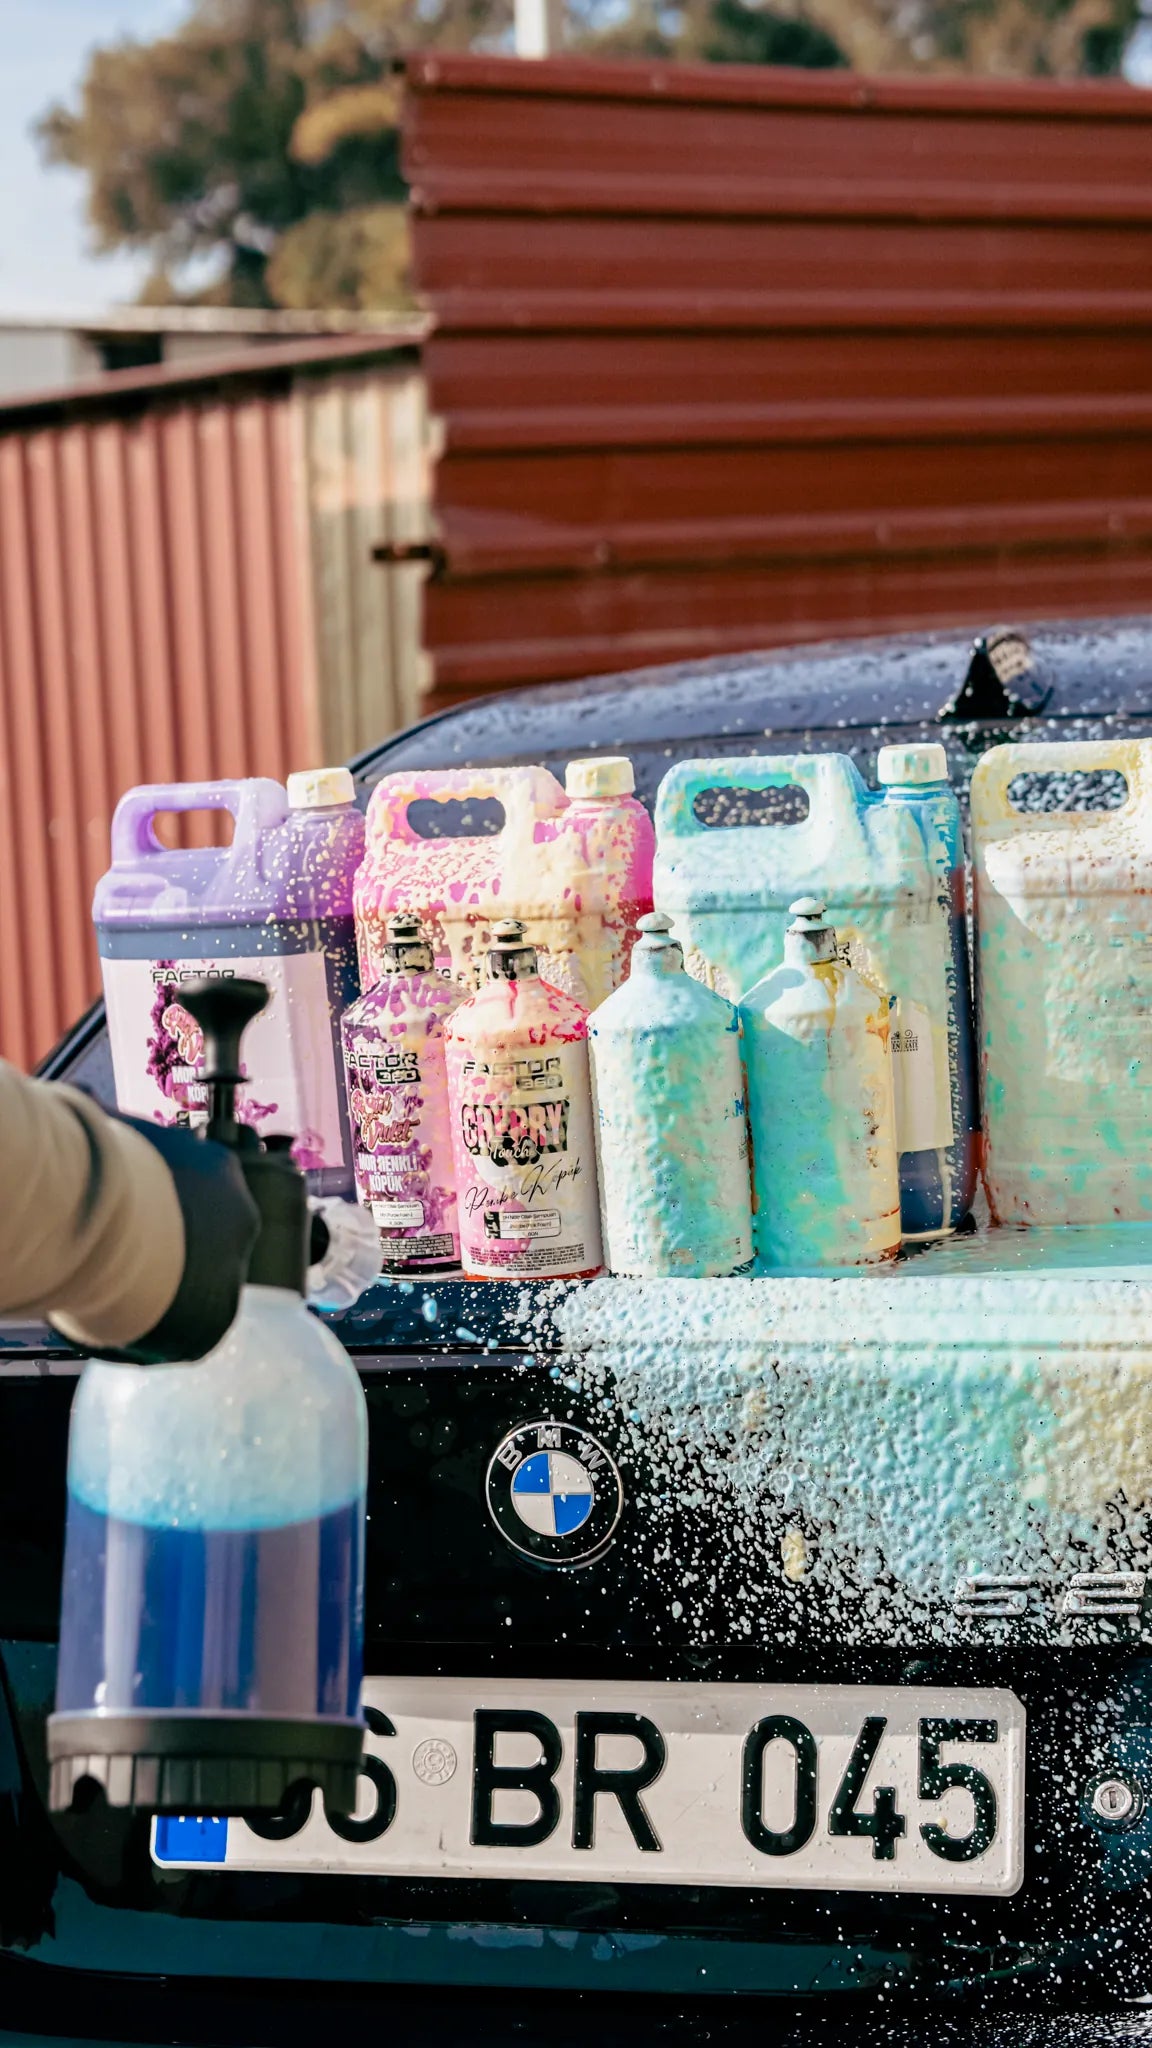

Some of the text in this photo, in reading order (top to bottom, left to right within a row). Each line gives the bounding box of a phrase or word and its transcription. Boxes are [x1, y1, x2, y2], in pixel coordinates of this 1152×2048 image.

[497, 1426, 607, 1471] BMW
[469, 1709, 667, 1852] BR
[740, 1714, 998, 1862] 045
